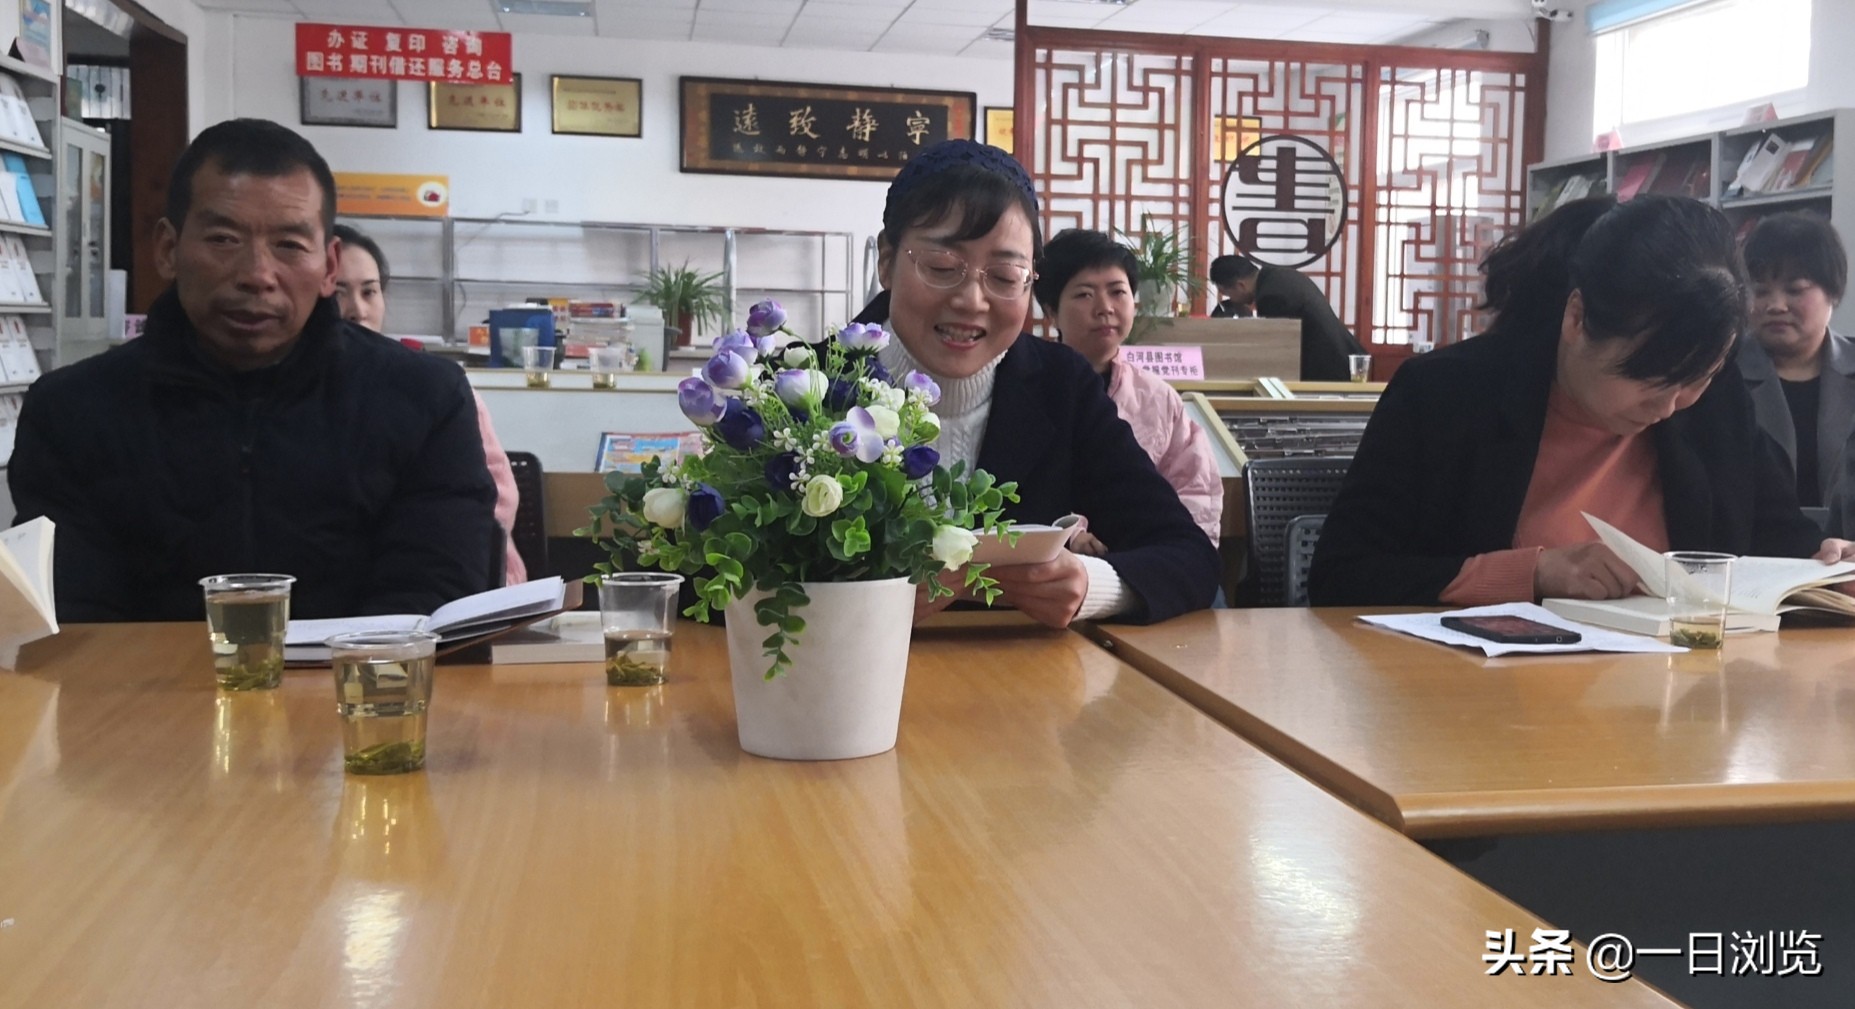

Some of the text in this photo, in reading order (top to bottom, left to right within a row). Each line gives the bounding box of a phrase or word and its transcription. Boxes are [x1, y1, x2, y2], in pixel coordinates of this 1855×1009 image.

[327, 29, 483, 56] 办证 复印 咨询
[1126, 351, 1183, 363] 白河县图书馆
